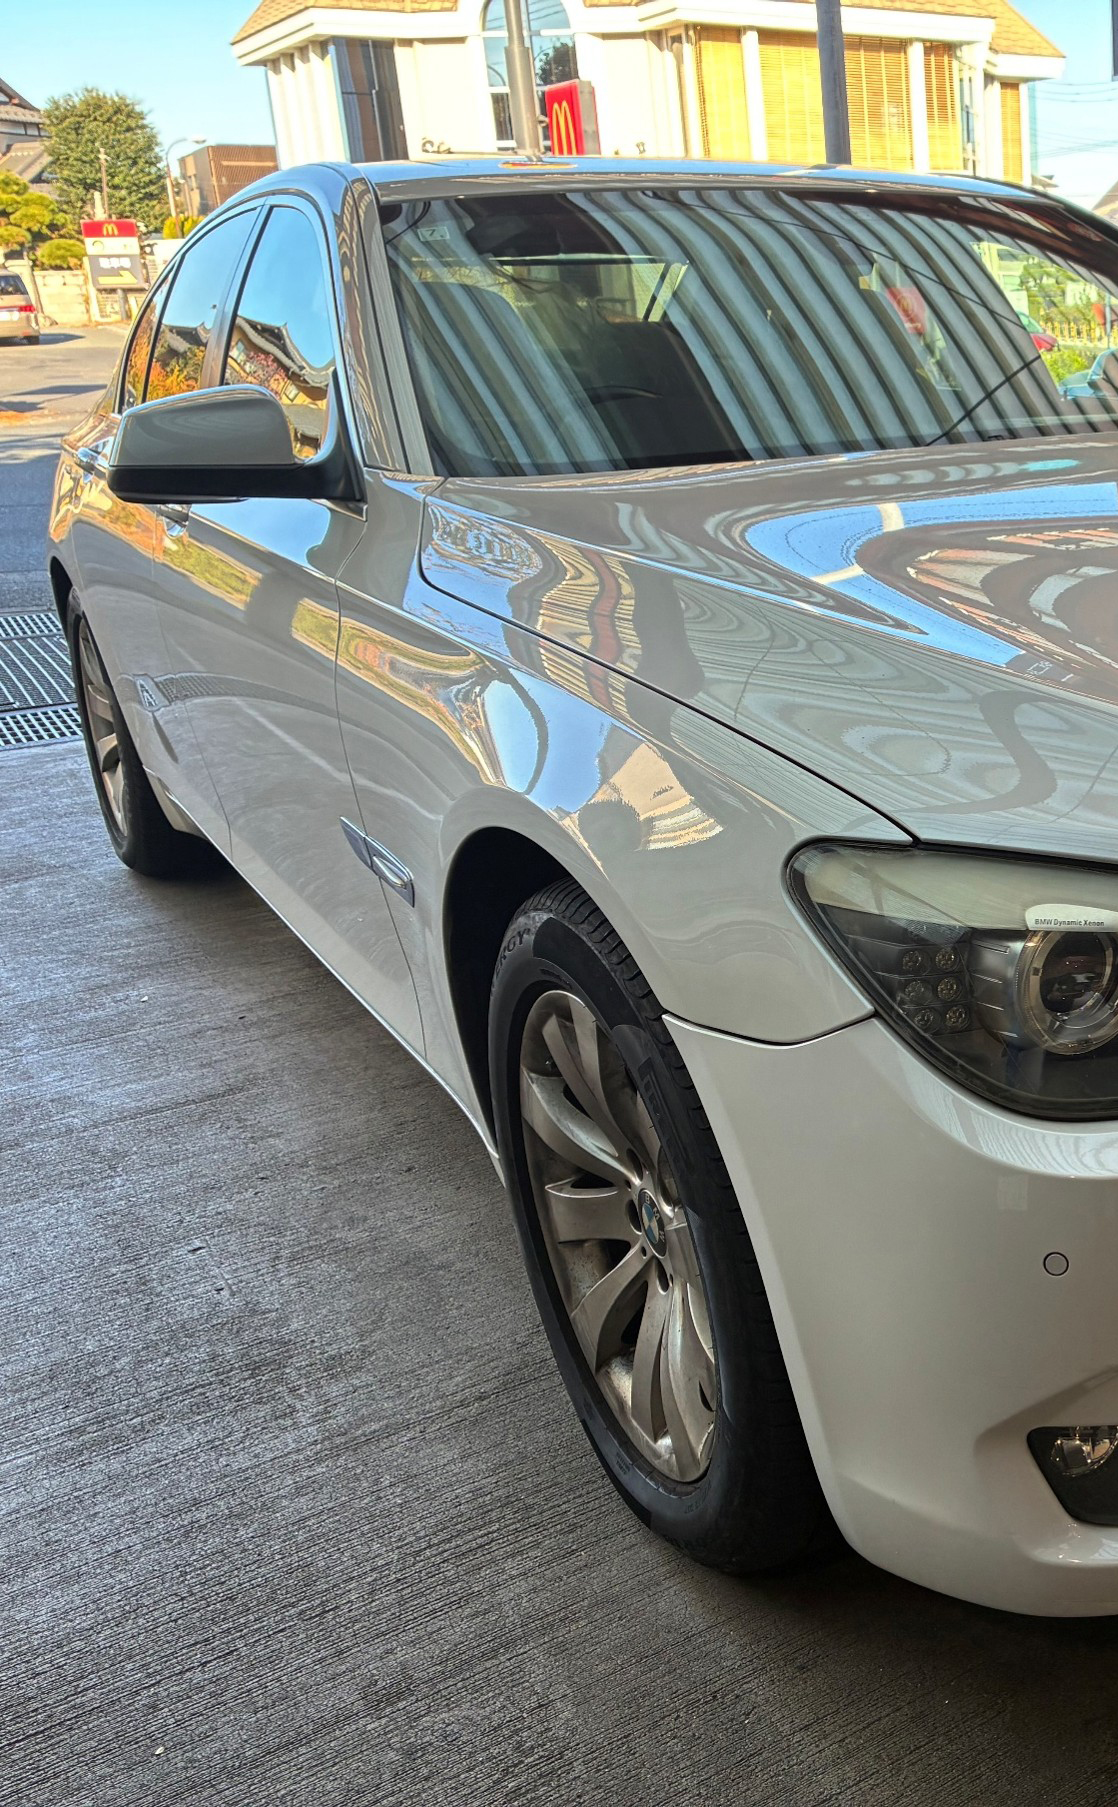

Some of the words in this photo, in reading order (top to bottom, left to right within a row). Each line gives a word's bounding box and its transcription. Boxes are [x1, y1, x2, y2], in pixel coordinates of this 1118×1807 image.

[1034, 918, 1053, 926] BMW
[1053, 919, 1083, 927] Dynamic
[1083, 919, 1105, 927] Xenon
